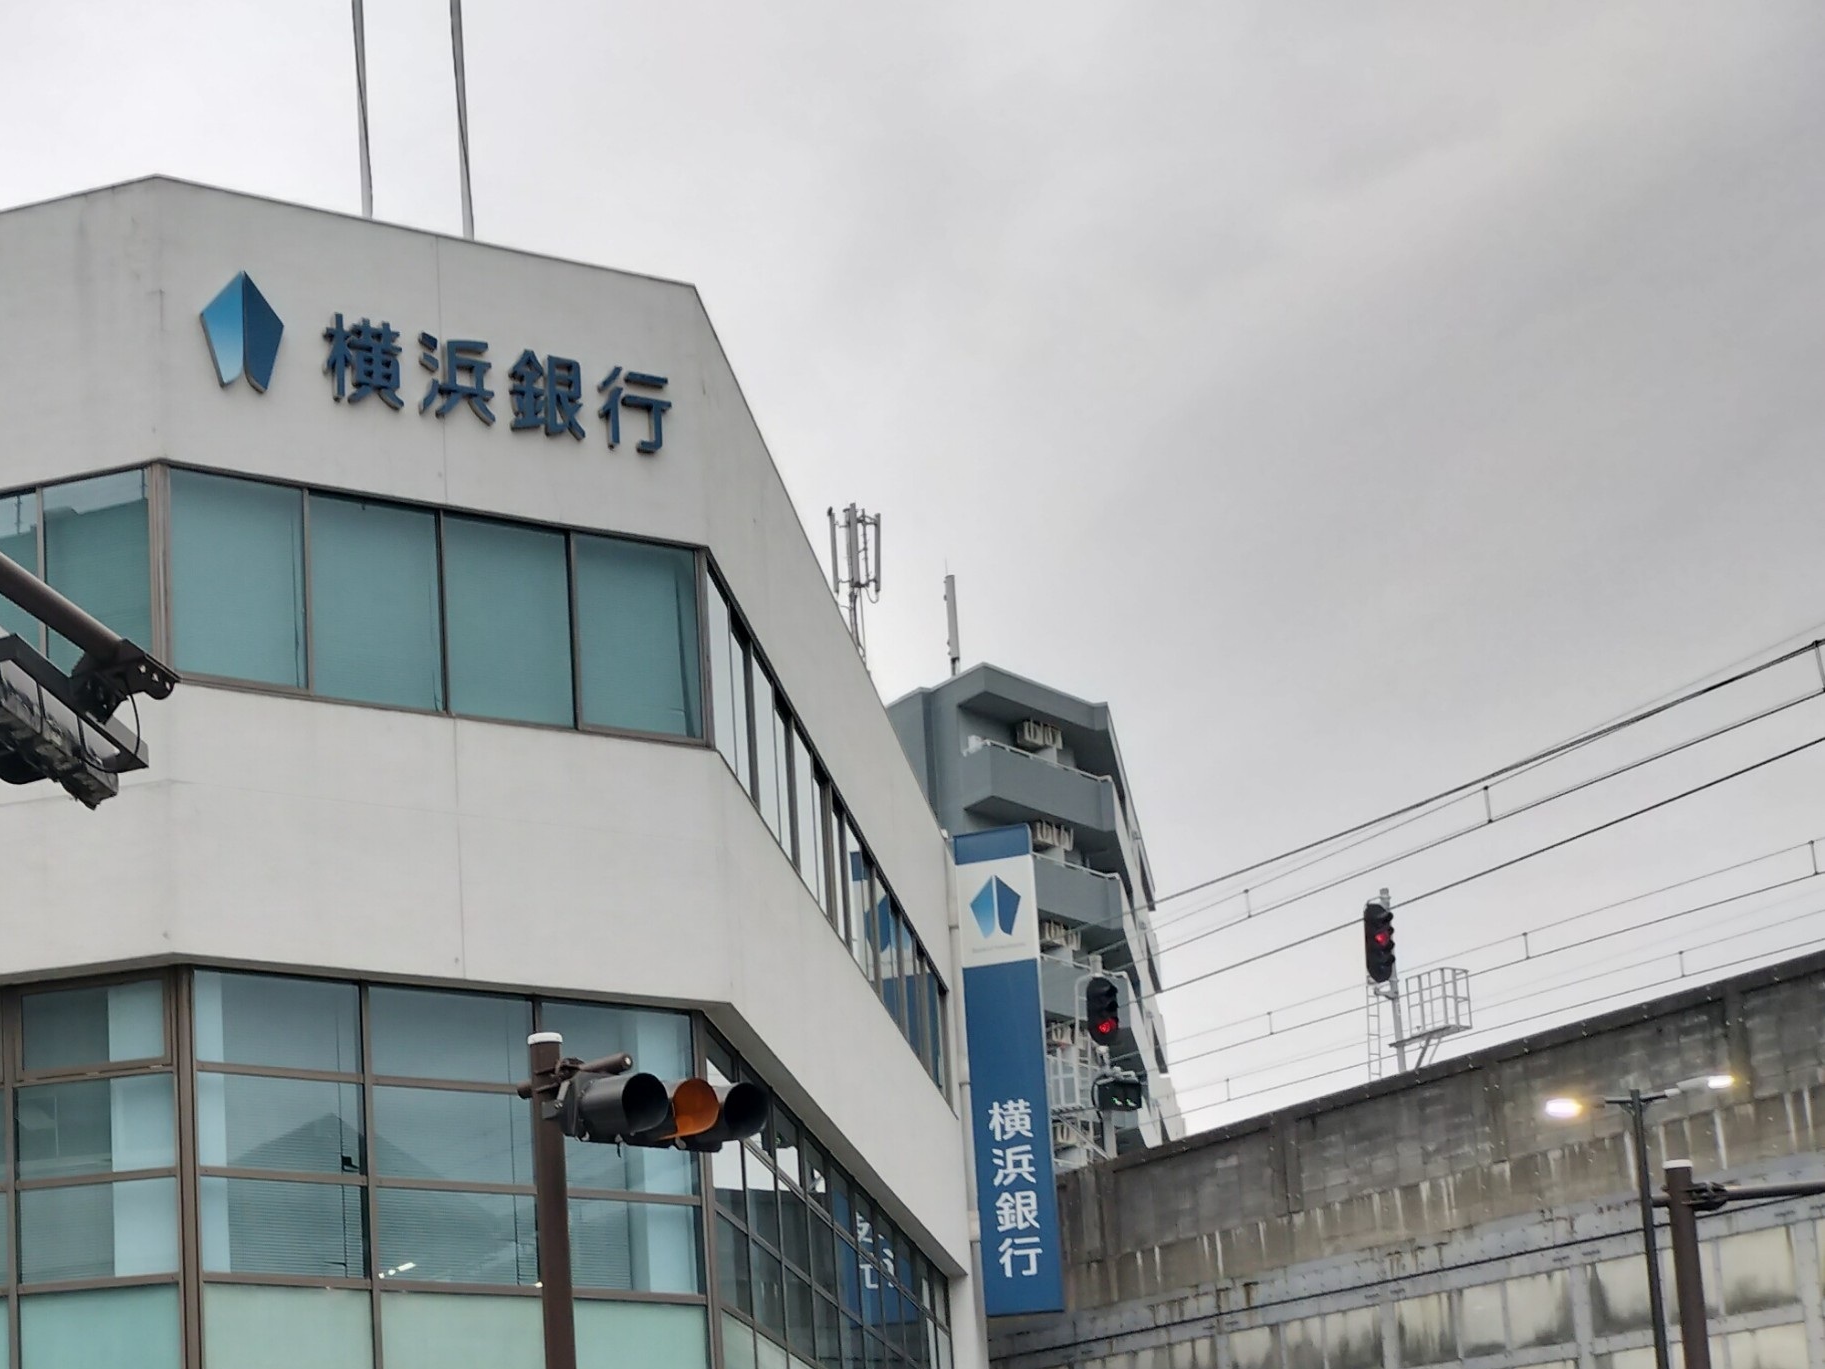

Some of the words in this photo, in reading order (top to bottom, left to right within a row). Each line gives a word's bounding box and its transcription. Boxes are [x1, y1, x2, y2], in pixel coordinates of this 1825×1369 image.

[323, 312, 672, 453] 横浜銀行
[987, 1099, 1043, 1278] 横浜銀行
